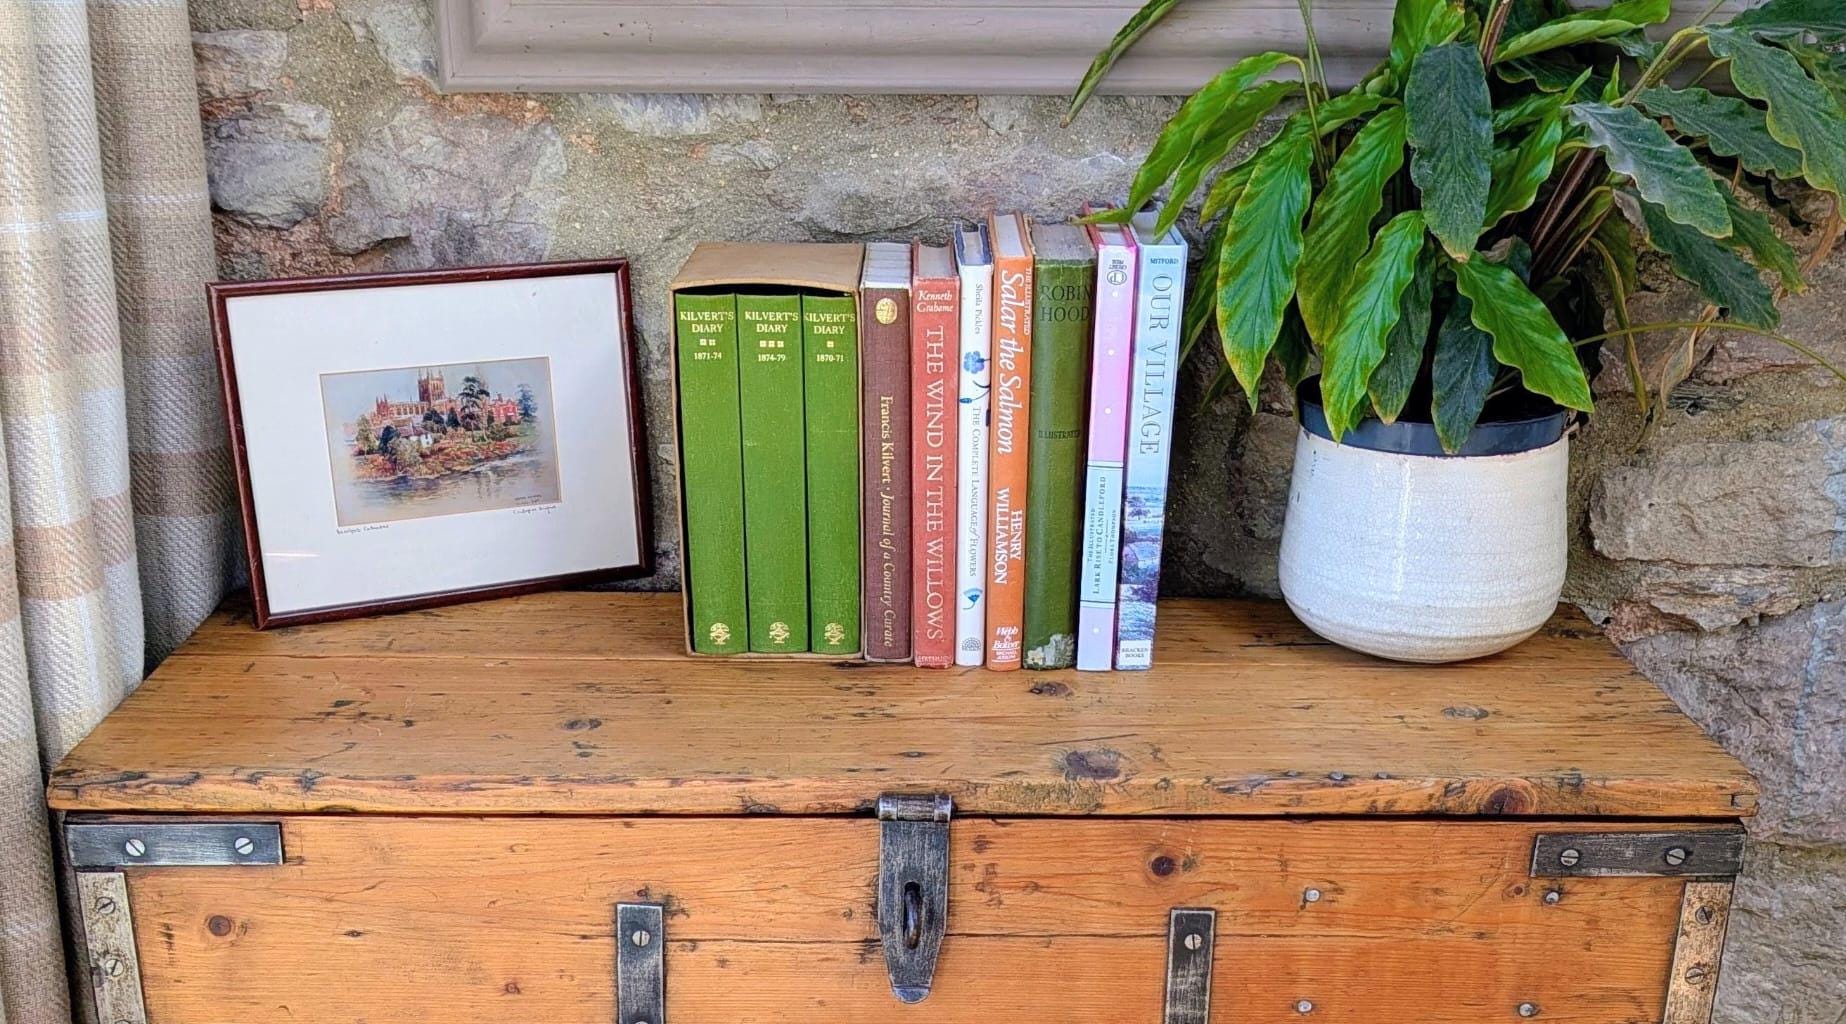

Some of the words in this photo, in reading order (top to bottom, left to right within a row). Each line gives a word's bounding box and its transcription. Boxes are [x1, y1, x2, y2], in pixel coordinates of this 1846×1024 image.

[1149, 257, 1179, 265] MITFORD
[916, 301, 954, 313] Grahame
[917, 289, 953, 301] Kenneth
[975, 283, 984, 306] Sheila
[1001, 269, 1025, 333] Salar
[1040, 285, 1093, 301] ROBIN
[1148, 275, 1173, 330] OUR
[679, 311, 735, 321] KILVERT'S
[744, 311, 799, 321] KILVERT'S
[803, 312, 856, 323] KILVERT'S
[974, 309, 984, 335] Pickles
[1023, 284, 1032, 336] ILLUSTRATED
[1040, 306, 1090, 322] HOOD
[691, 323, 724, 333] DIARY
[756, 323, 788, 333] DIARY
[813, 325, 845, 335] DIARY
[757, 353, 786, 362] 1874-79
[816, 354, 845, 363] 1870-71
[926, 325, 944, 374] THE
[1000, 338, 1024, 371] the
[1138, 340, 1168, 455] VILLAGE
[880, 396, 894, 439] Francis
[926, 378, 944, 448] WIND
[972, 407, 981, 425] THE
[997, 375, 1023, 455] Salmon
[880, 442, 895, 484] Kilvert
[971, 428, 981, 476] COMPLETE
[926, 455, 944, 482] IN
[879, 491, 895, 537] Journal
[926, 489, 944, 532] THE
[970, 479, 980, 525] LANGUAGE
[1095, 476, 1106, 536] CANDLEFORD
[879, 537, 896, 551] of
[994, 487, 1010, 585] WILLIAMSON
[1010, 509, 1023, 560] HENRY
[1096, 537, 1103, 547] TO
[969, 538, 979, 577] FLOWERS
[1093, 546, 1103, 570] RISE
[880, 562, 896, 606] Country
[926, 537, 944, 640] WILLOWS
[1092, 571, 1101, 595] LARK
[883, 609, 896, 648] Curate
